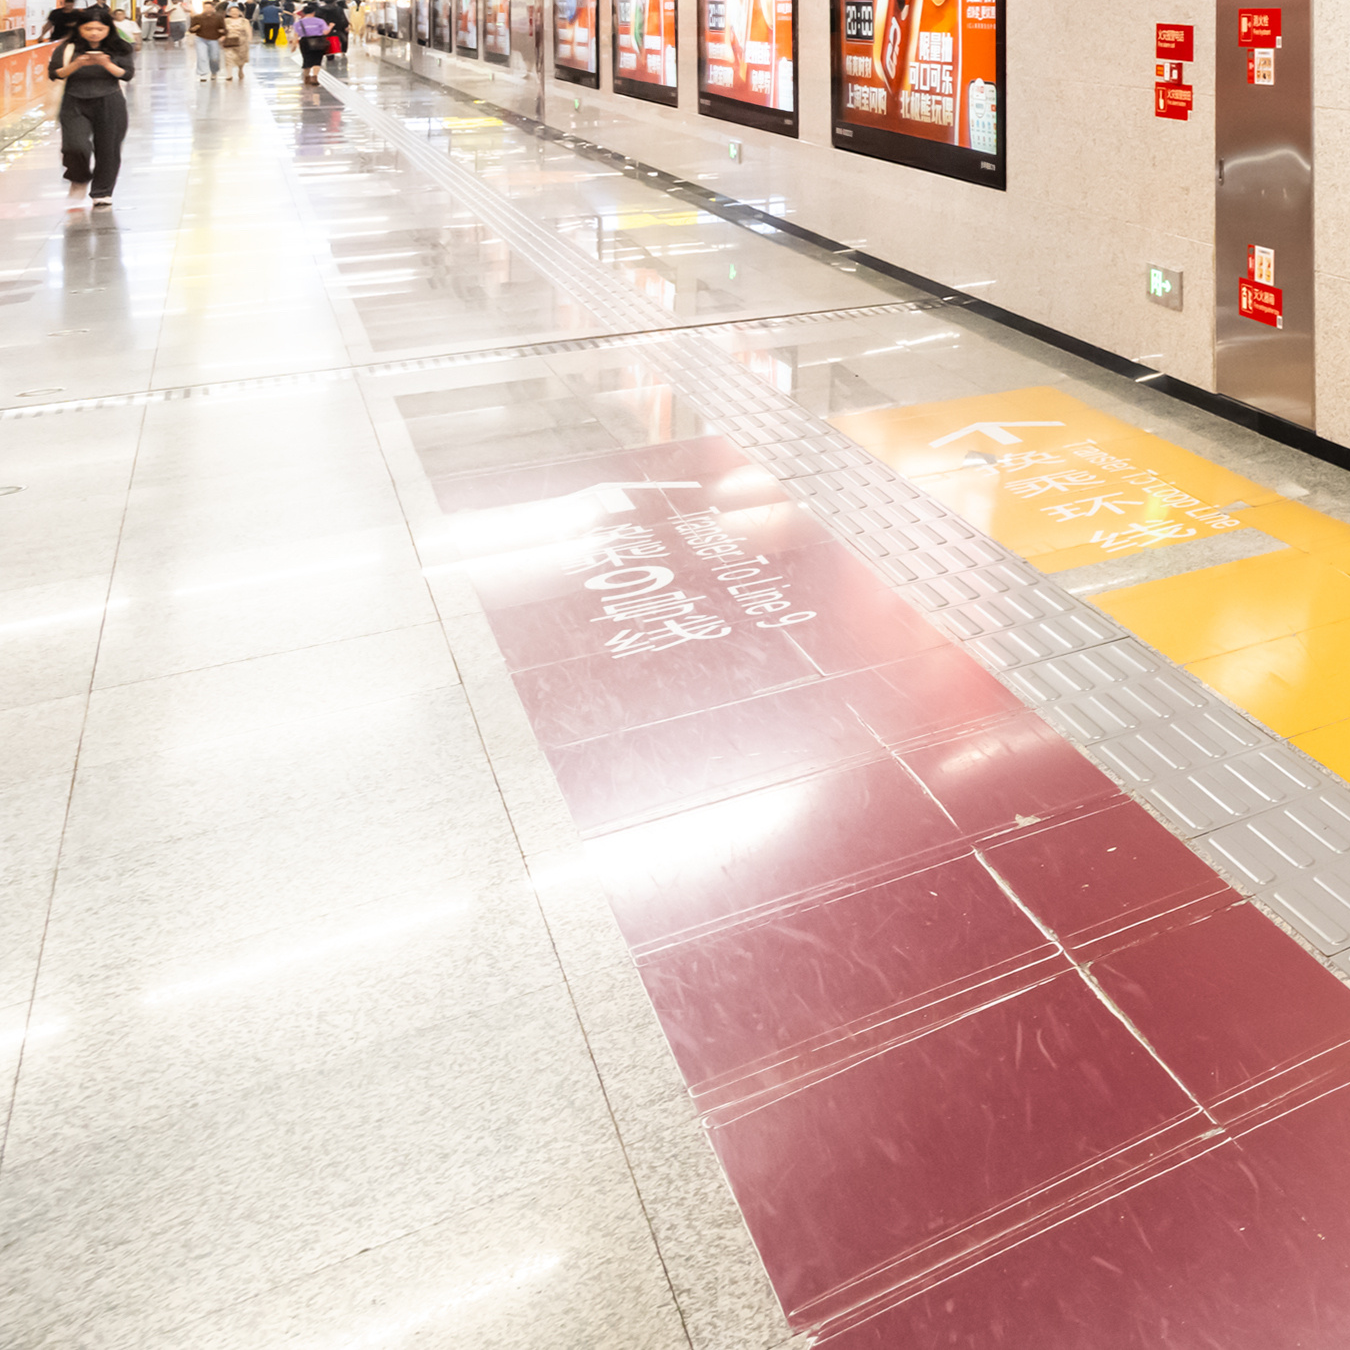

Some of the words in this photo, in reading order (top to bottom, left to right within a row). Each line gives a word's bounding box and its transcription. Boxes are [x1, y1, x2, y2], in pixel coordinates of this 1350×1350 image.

[909, 62, 953, 95] 可口可乐
[1063, 439, 1135, 472] Transfer
[1142, 481, 1200, 509] Loop
[1185, 505, 1240, 529] Line
[667, 506, 748, 560] Transfer
[711, 554, 769, 581] To
[727, 576, 791, 615] Line
[756, 611, 817, 628] 9
